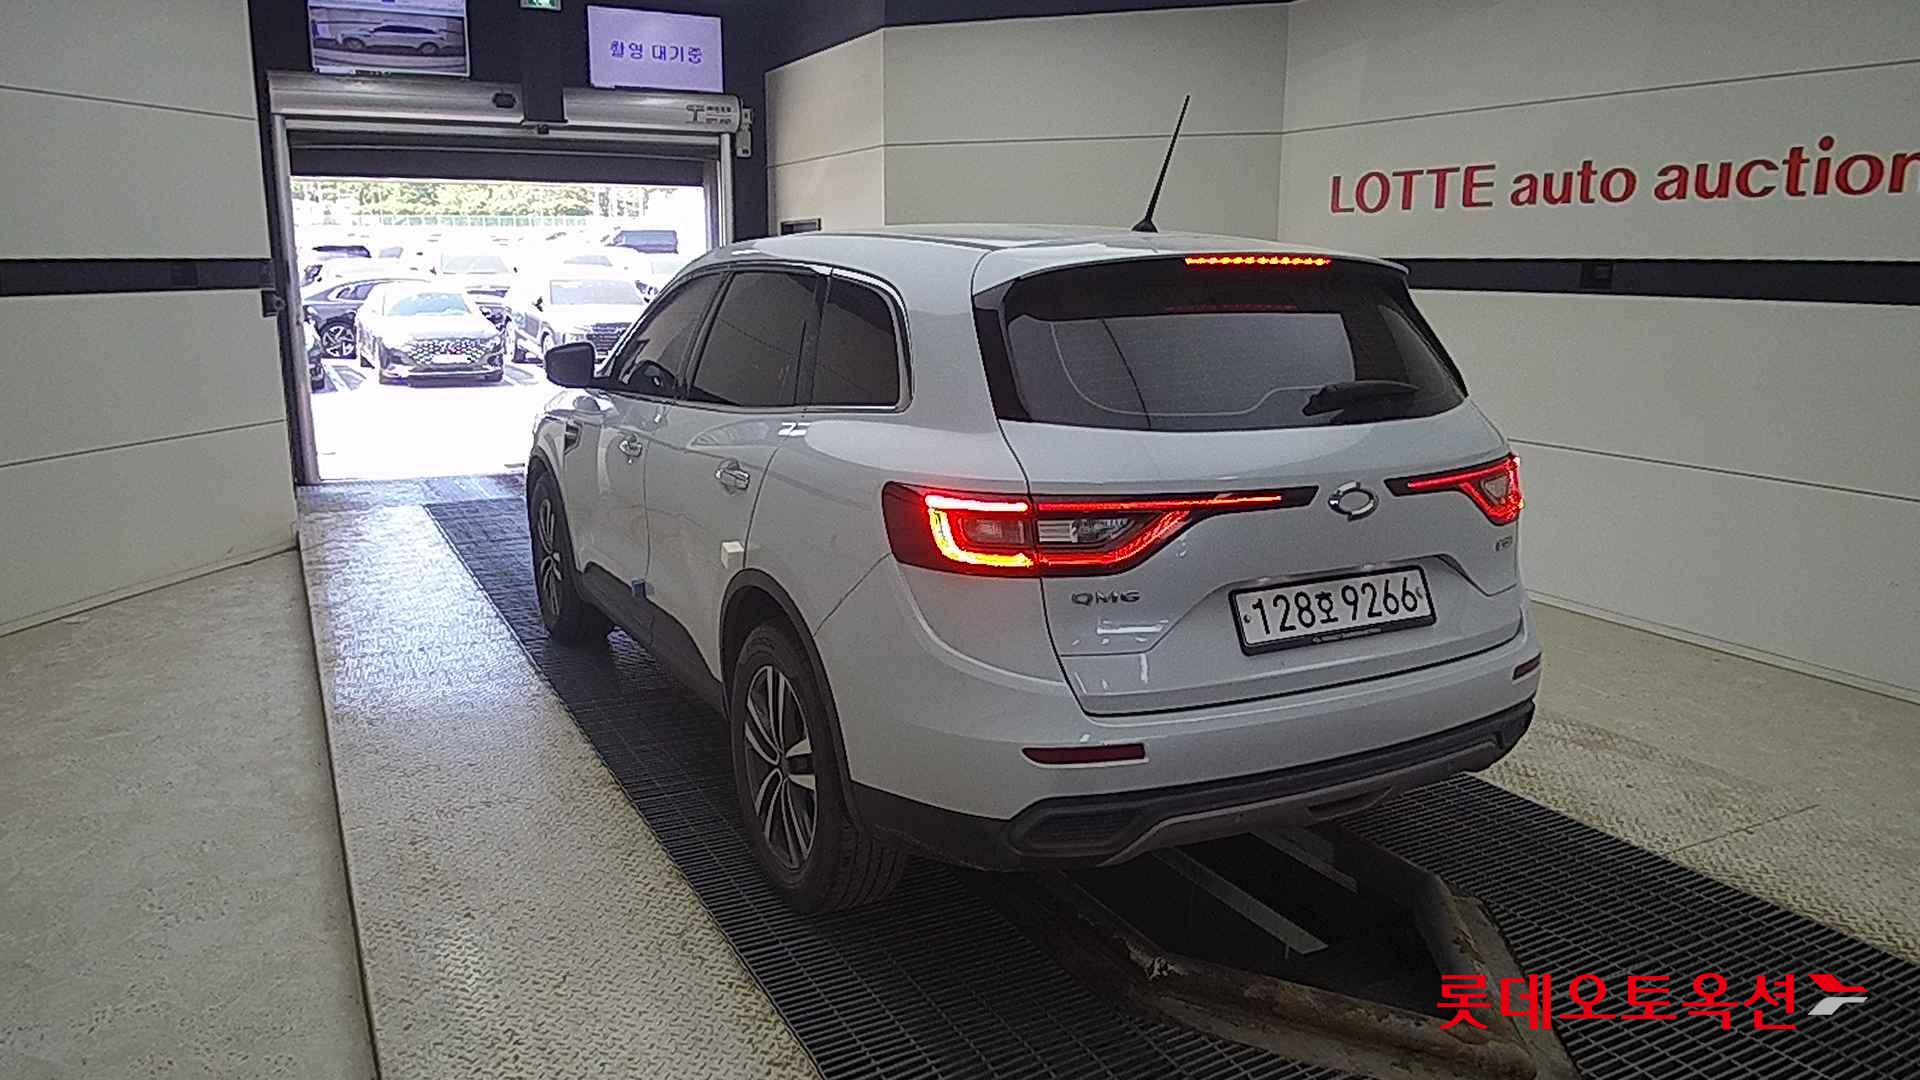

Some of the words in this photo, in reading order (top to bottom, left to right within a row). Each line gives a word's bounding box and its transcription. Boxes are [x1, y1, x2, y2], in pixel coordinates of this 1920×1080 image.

[610, 40, 643, 60] 촬영
[652, 44, 703, 65] 대기중
[1330, 164, 1497, 214] LOTTE
[1509, 160, 1637, 207] auto
